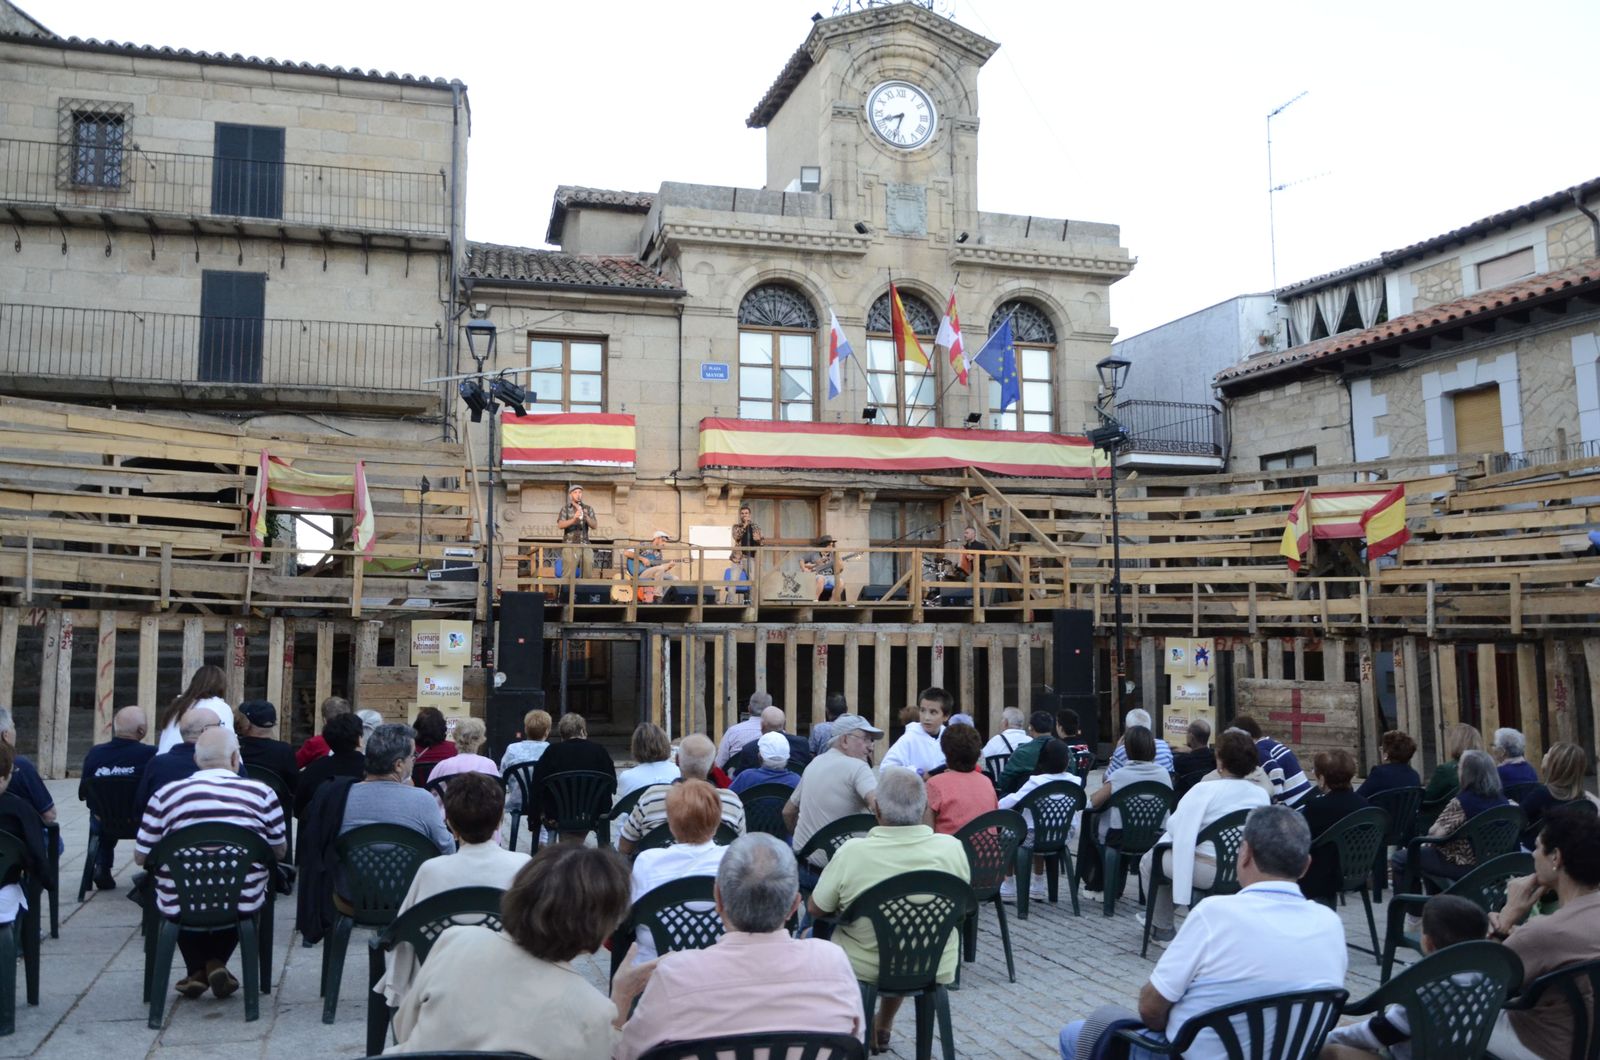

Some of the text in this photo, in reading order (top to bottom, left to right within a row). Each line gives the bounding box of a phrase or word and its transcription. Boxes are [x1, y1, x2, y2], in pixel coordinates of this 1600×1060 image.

[885, 90, 895, 101] XI
[896, 88, 907, 99] XII
[877, 97, 887, 106] X
[916, 102, 925, 110] II
[874, 108, 884, 118] IX
[919, 114, 929, 123] III
[911, 133, 919, 142] V
[28, 608, 47, 628] 12
[417, 633, 440, 644] Escenario
[413, 641, 440, 651] Patrimonio
